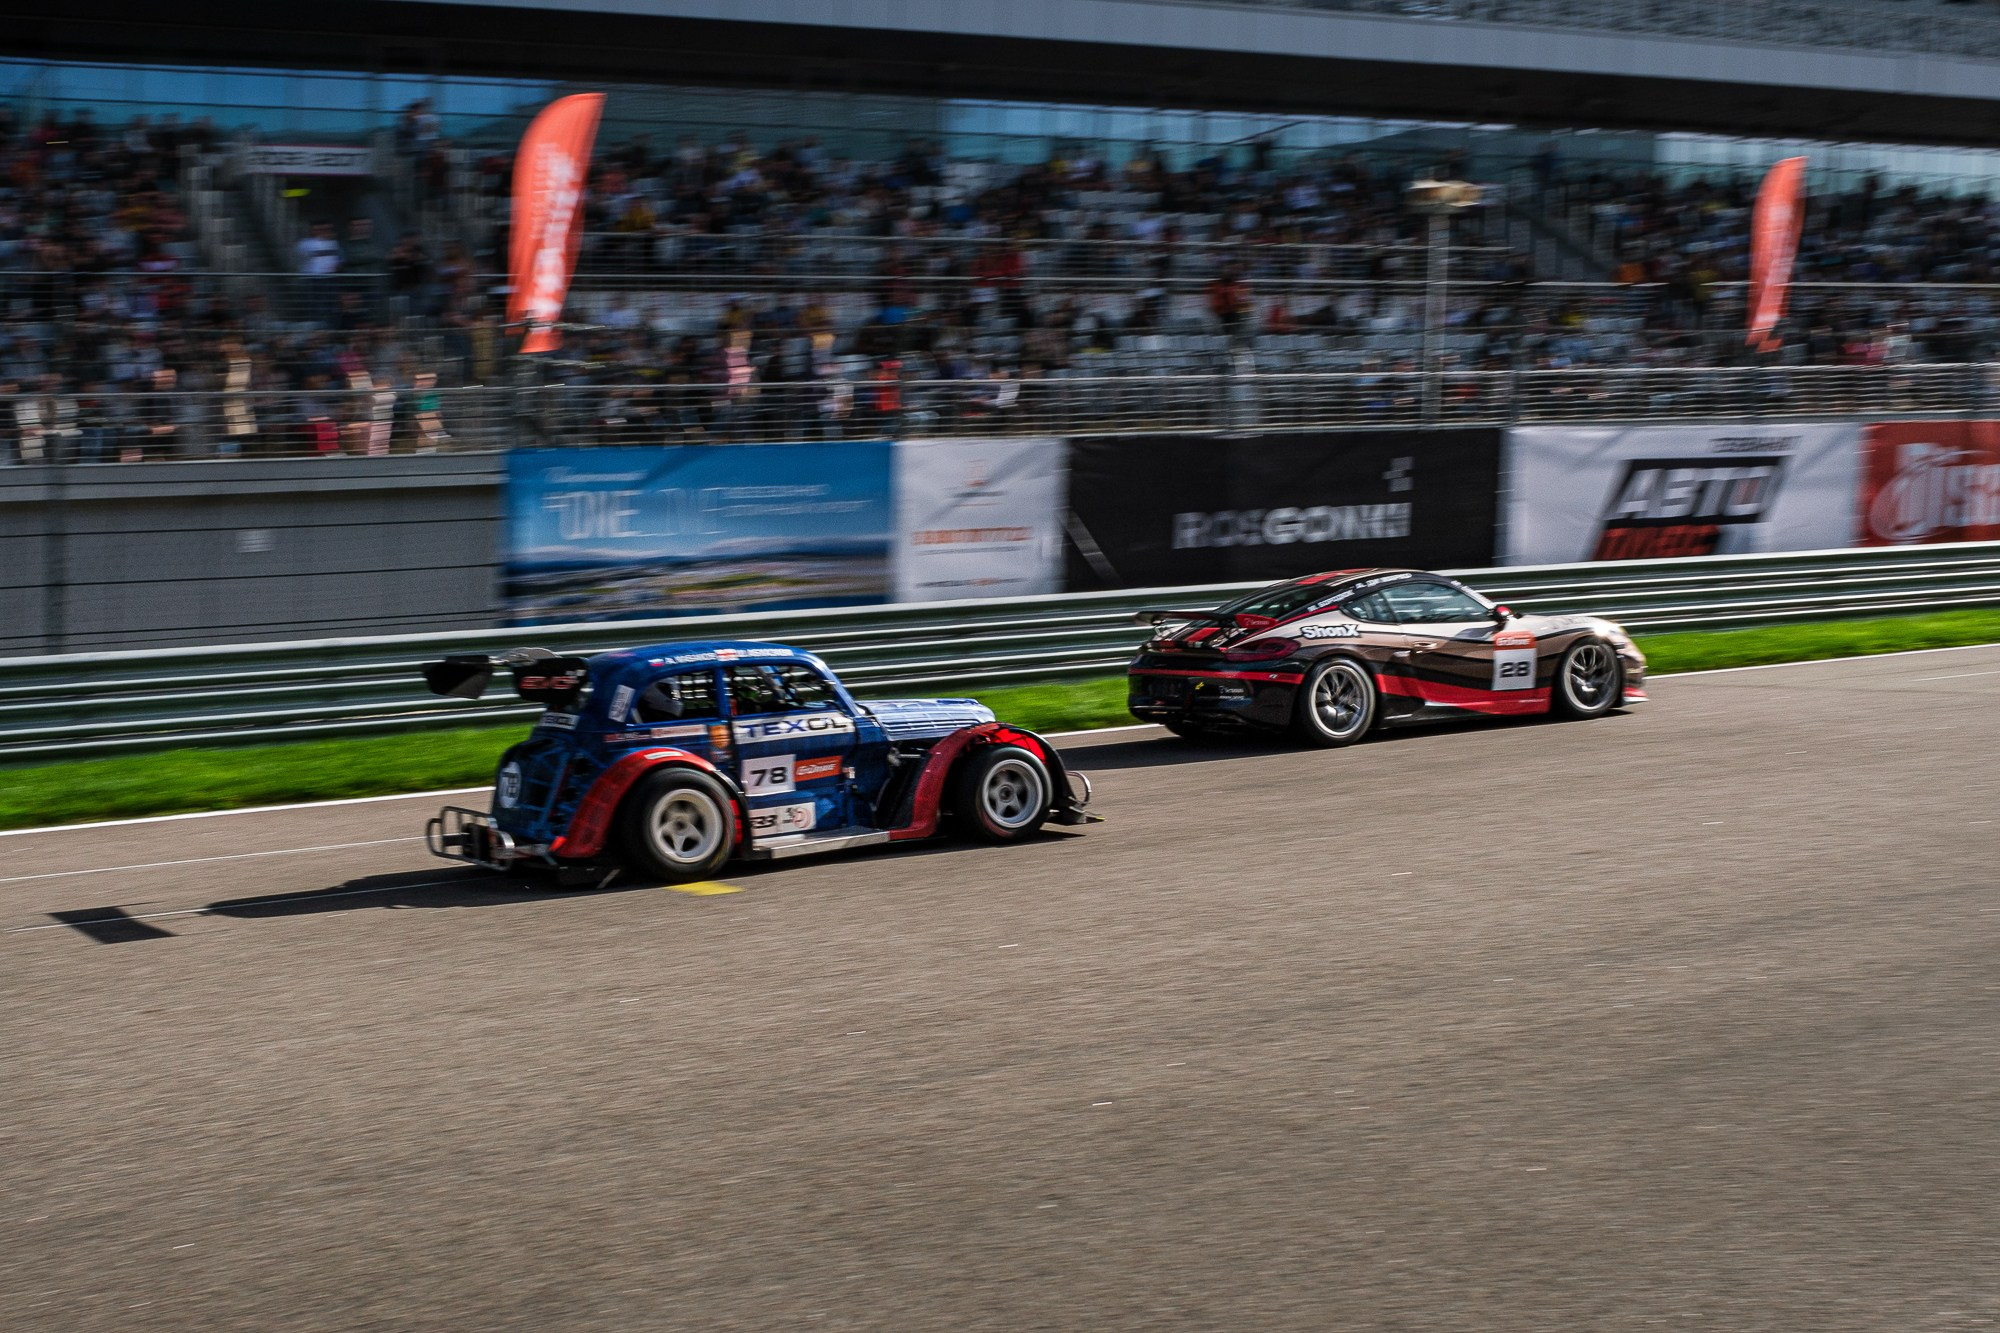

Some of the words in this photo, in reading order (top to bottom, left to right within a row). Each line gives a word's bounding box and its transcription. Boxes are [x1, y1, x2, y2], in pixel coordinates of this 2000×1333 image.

[1301, 624, 1360, 639] ShonX
[1501, 661, 1531, 678] 28
[750, 766, 787, 787] 78
